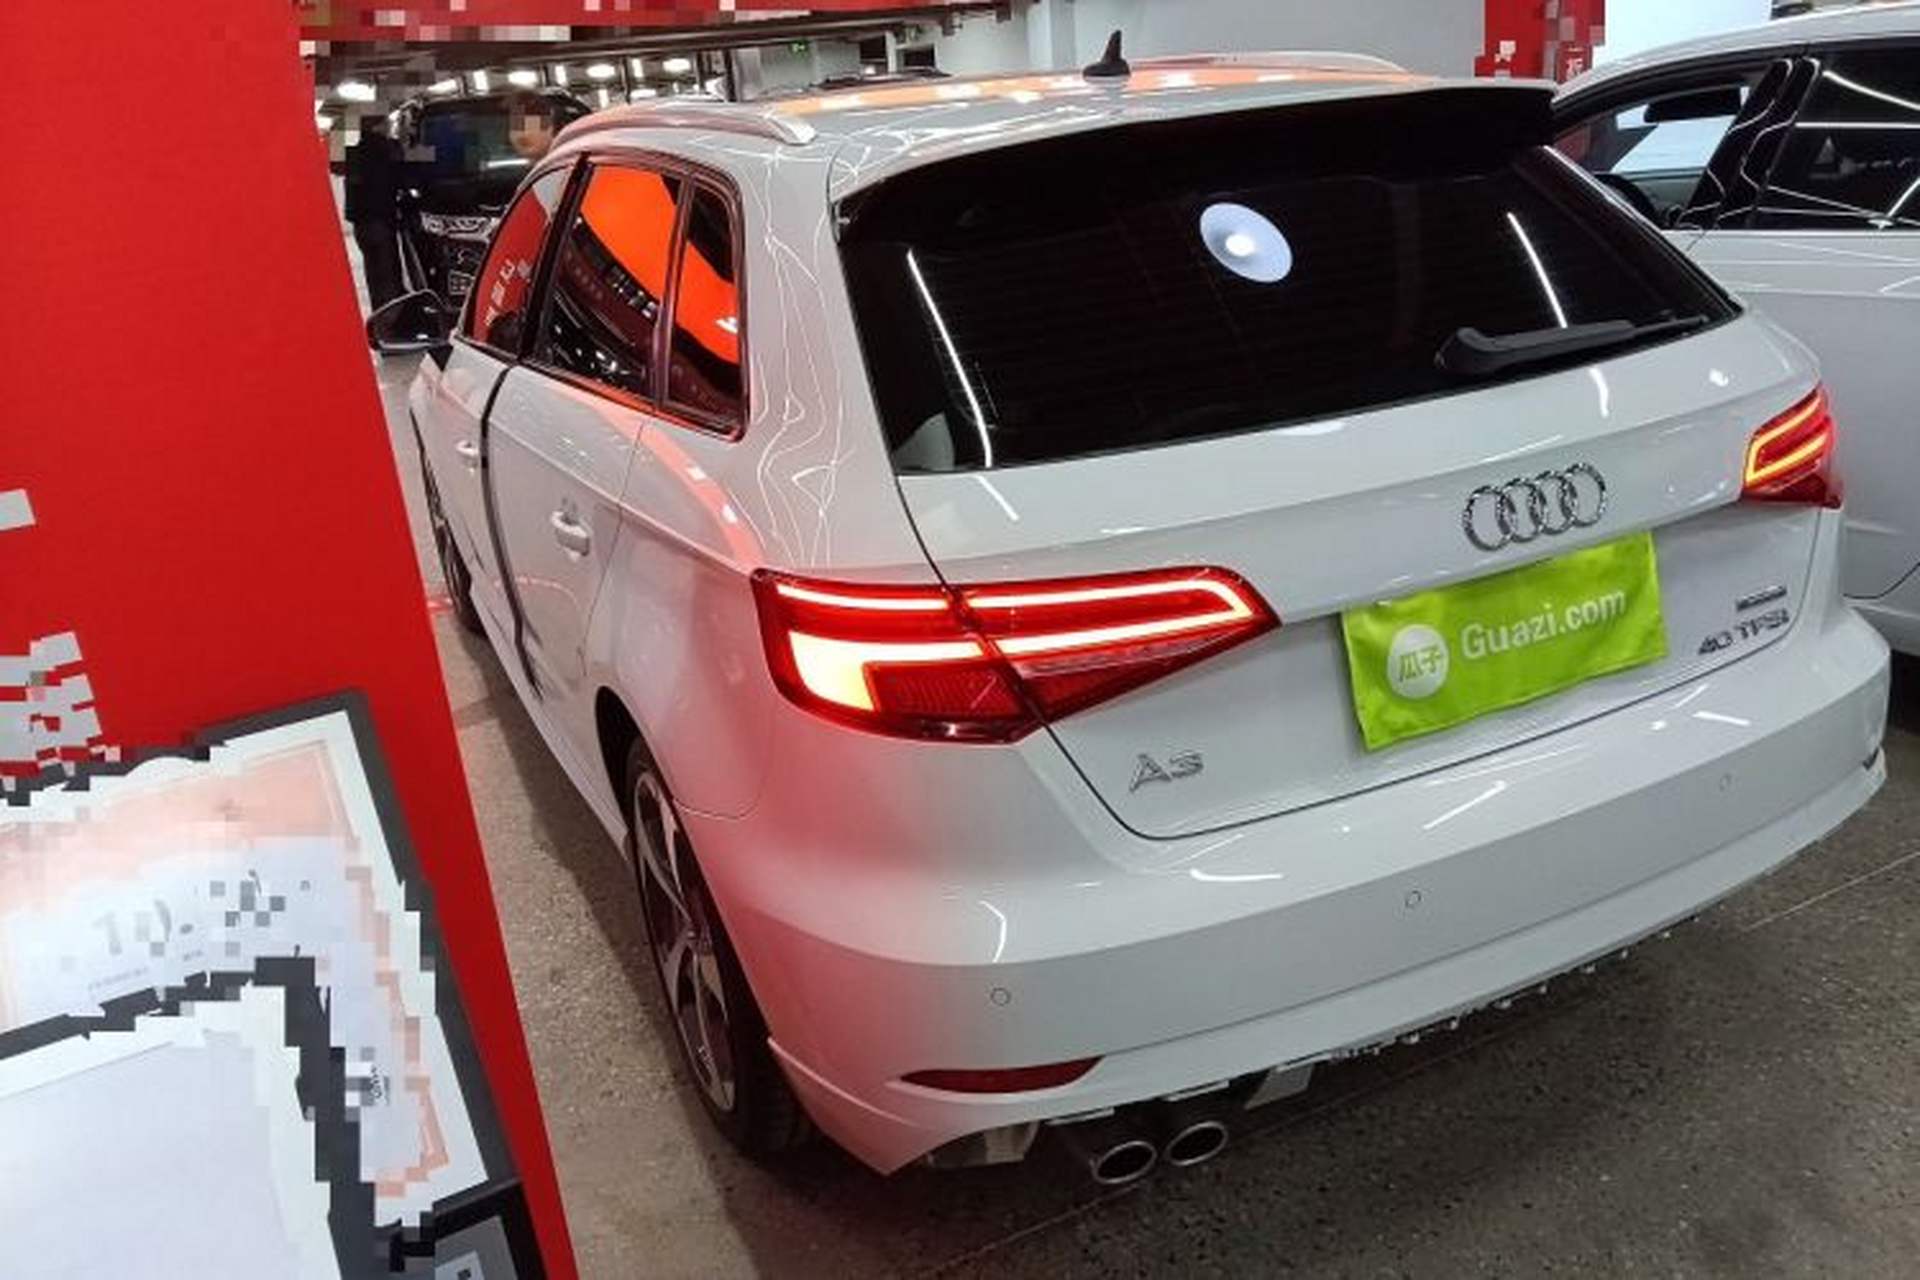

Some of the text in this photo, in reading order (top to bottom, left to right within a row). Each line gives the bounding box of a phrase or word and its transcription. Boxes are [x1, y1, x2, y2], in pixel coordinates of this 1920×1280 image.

[1460, 591, 1627, 660] Guazi.com
[1698, 631, 1734, 655] 40
[1128, 753, 1204, 793] A3
